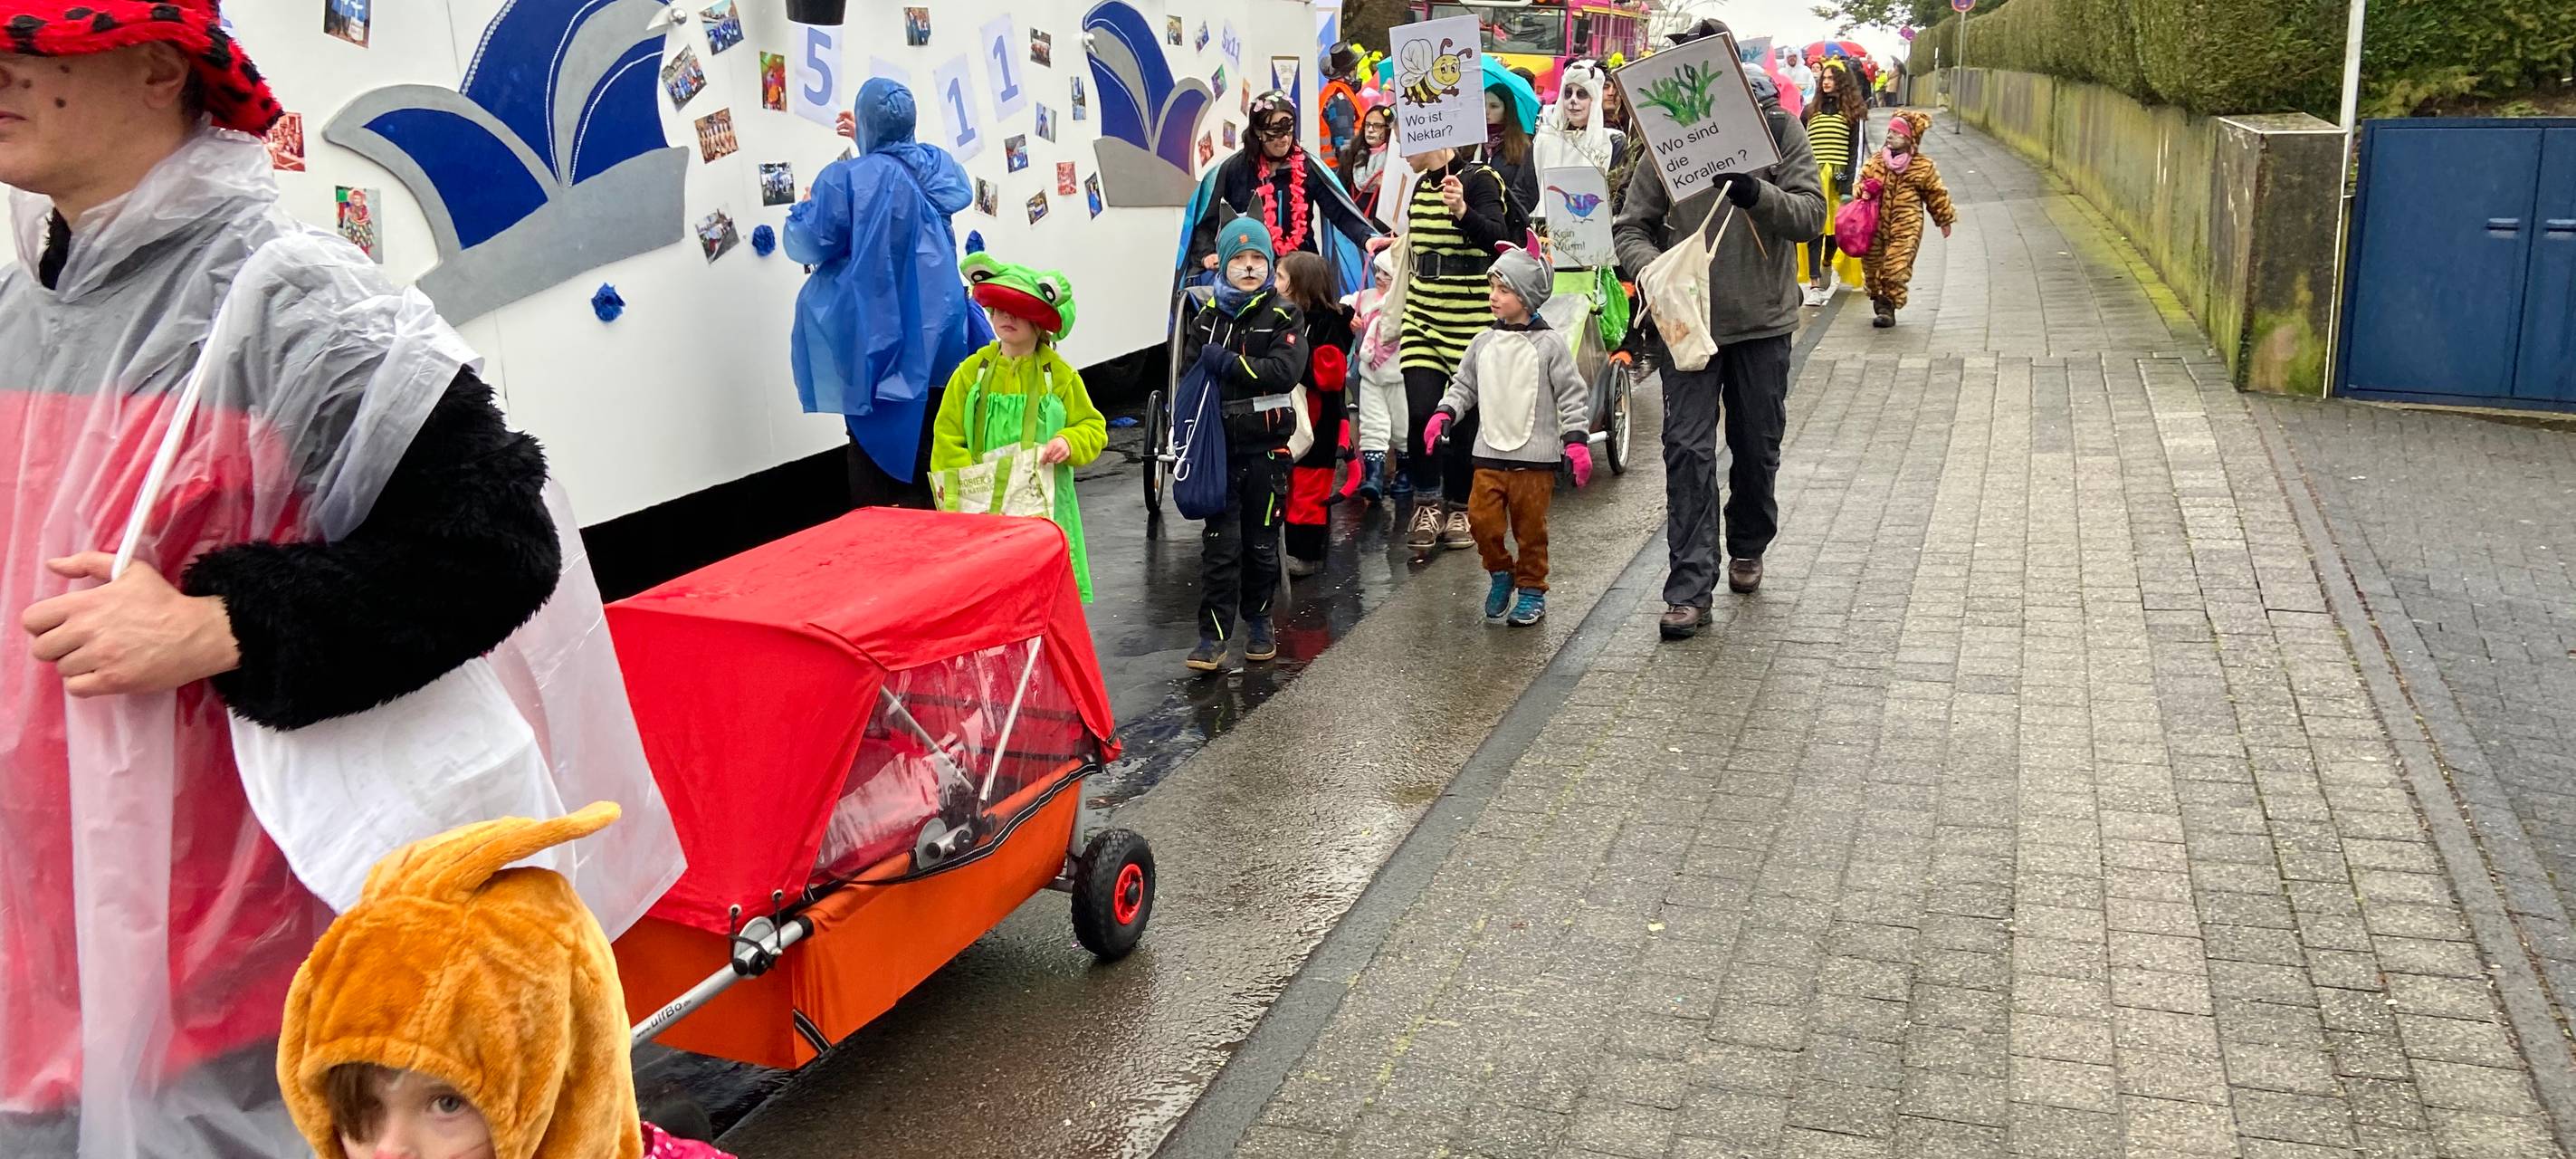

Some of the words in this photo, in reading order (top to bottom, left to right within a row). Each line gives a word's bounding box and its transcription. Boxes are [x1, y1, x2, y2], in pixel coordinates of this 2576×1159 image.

[804, 27, 833, 106] 5
[948, 77, 976, 147] 1
[993, 34, 1018, 102] 1
[1406, 114, 1426, 127] Wo
[1429, 111, 1443, 123] ist
[1407, 125, 1453, 143] Nektar?
[1656, 139, 1684, 156] Wo
[1687, 121, 1720, 143] sind
[1666, 156, 1689, 172] die
[1673, 157, 1736, 188] Korallen
[1738, 149, 1748, 161] ?
